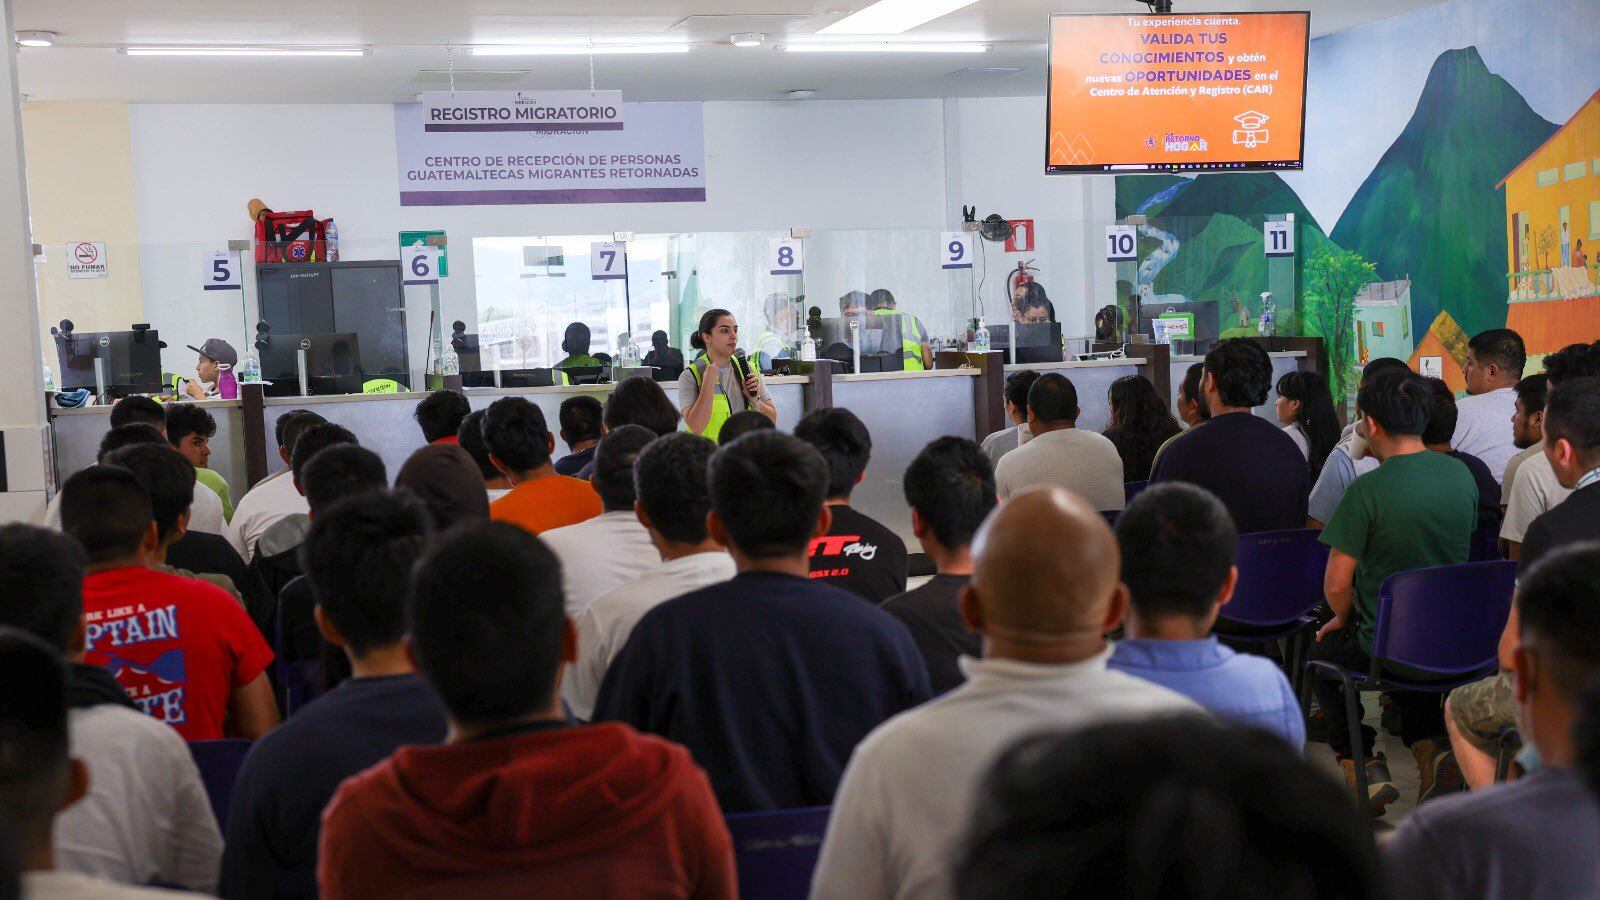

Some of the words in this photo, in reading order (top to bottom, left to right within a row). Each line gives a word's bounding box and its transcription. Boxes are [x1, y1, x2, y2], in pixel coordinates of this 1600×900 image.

[1127, 17, 1141, 26] Tu
[1142, 17, 1201, 28] experiencia
[1203, 18, 1241, 26] cuenta.
[1140, 33, 1194, 45] VALIDA
[1198, 33, 1227, 44] TUS
[1100, 51, 1225, 64] CONOCIMIENTOS
[1228, 55, 1235, 64] y
[1236, 53, 1266, 63] obtén
[1085, 74, 1122, 83] nuevas
[1125, 69, 1251, 82] OPORTUNIDADES
[1254, 73, 1267, 81] en
[1090, 87, 1125, 97] Centro
[1127, 86, 1140, 96] de
[1142, 84, 1188, 96] Atención
[1190, 88, 1197, 97] y
[1199, 85, 1241, 97] Registro
[1243, 85, 1272, 96] (CAR)
[431, 108, 510, 121] REGISTRO
[516, 106, 617, 120] MIGRATORIO
[424, 156, 481, 167] CENTRO
[486, 156, 504, 167] DE
[507, 153, 586, 166] RECEPCIÓN
[589, 155, 607, 166] DE
[611, 154, 681, 165] PERSONAS
[407, 169, 524, 181] GUATEMALTECAS
[528, 168, 606, 179] MIGRANTES
[609, 167, 699, 179] RETORNADAS
[1109, 234, 1134, 255] 10
[1270, 230, 1287, 250] 11
[777, 246, 794, 267] 8
[949, 241, 964, 261] 9
[412, 255, 429, 277] 6
[600, 250, 616, 271] 7
[213, 260, 230, 281] 5
[85, 604, 179, 649] PTAIN
